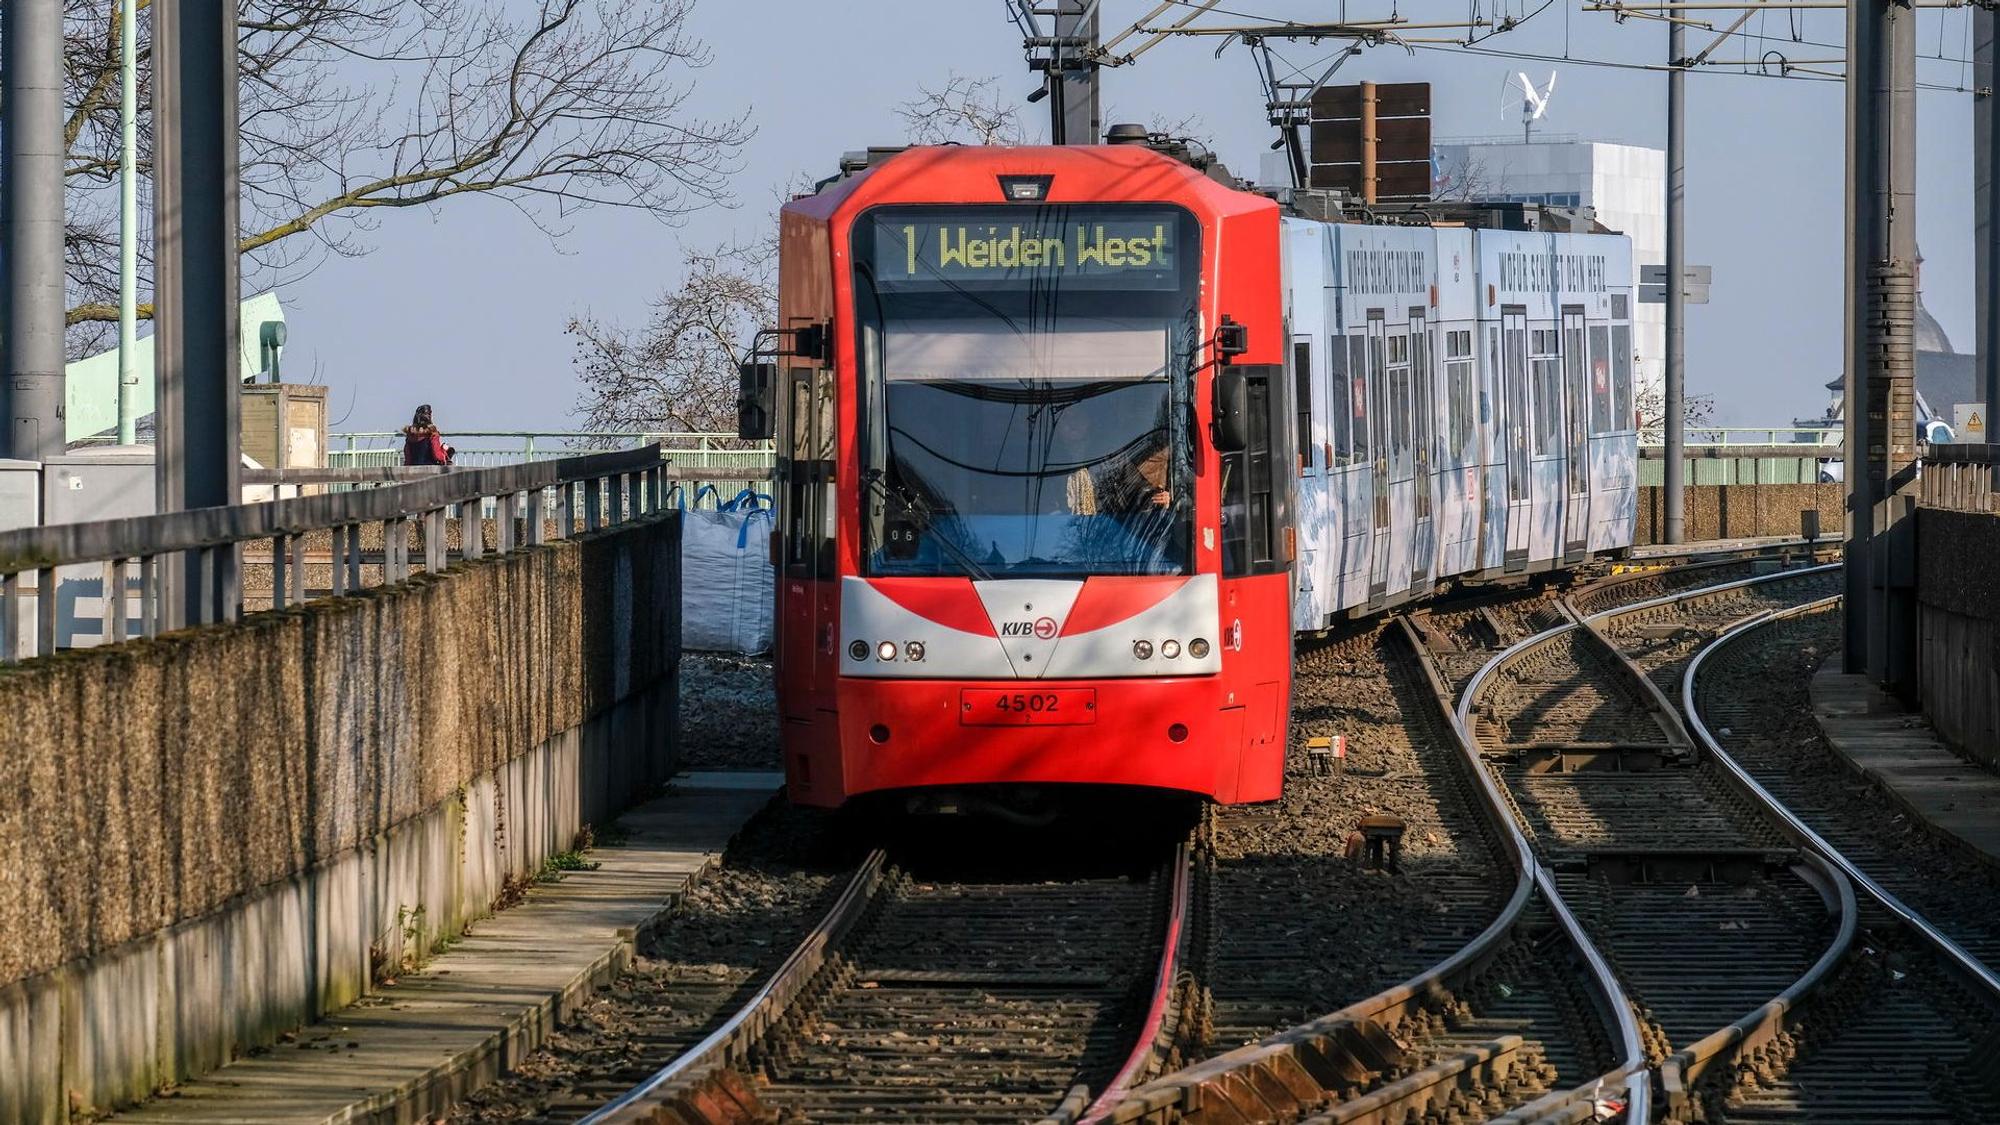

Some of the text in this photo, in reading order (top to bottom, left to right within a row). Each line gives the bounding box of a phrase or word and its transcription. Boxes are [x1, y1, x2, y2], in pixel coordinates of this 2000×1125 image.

[903, 224, 1167, 275] 1 Weiden West
[1499, 244, 1529, 292] WOFÜR
[1566, 254, 1585, 292] DEIN
[1587, 255, 1606, 292] HERZ
[1002, 622, 1034, 636] KVB
[996, 694, 1059, 712] 4502
